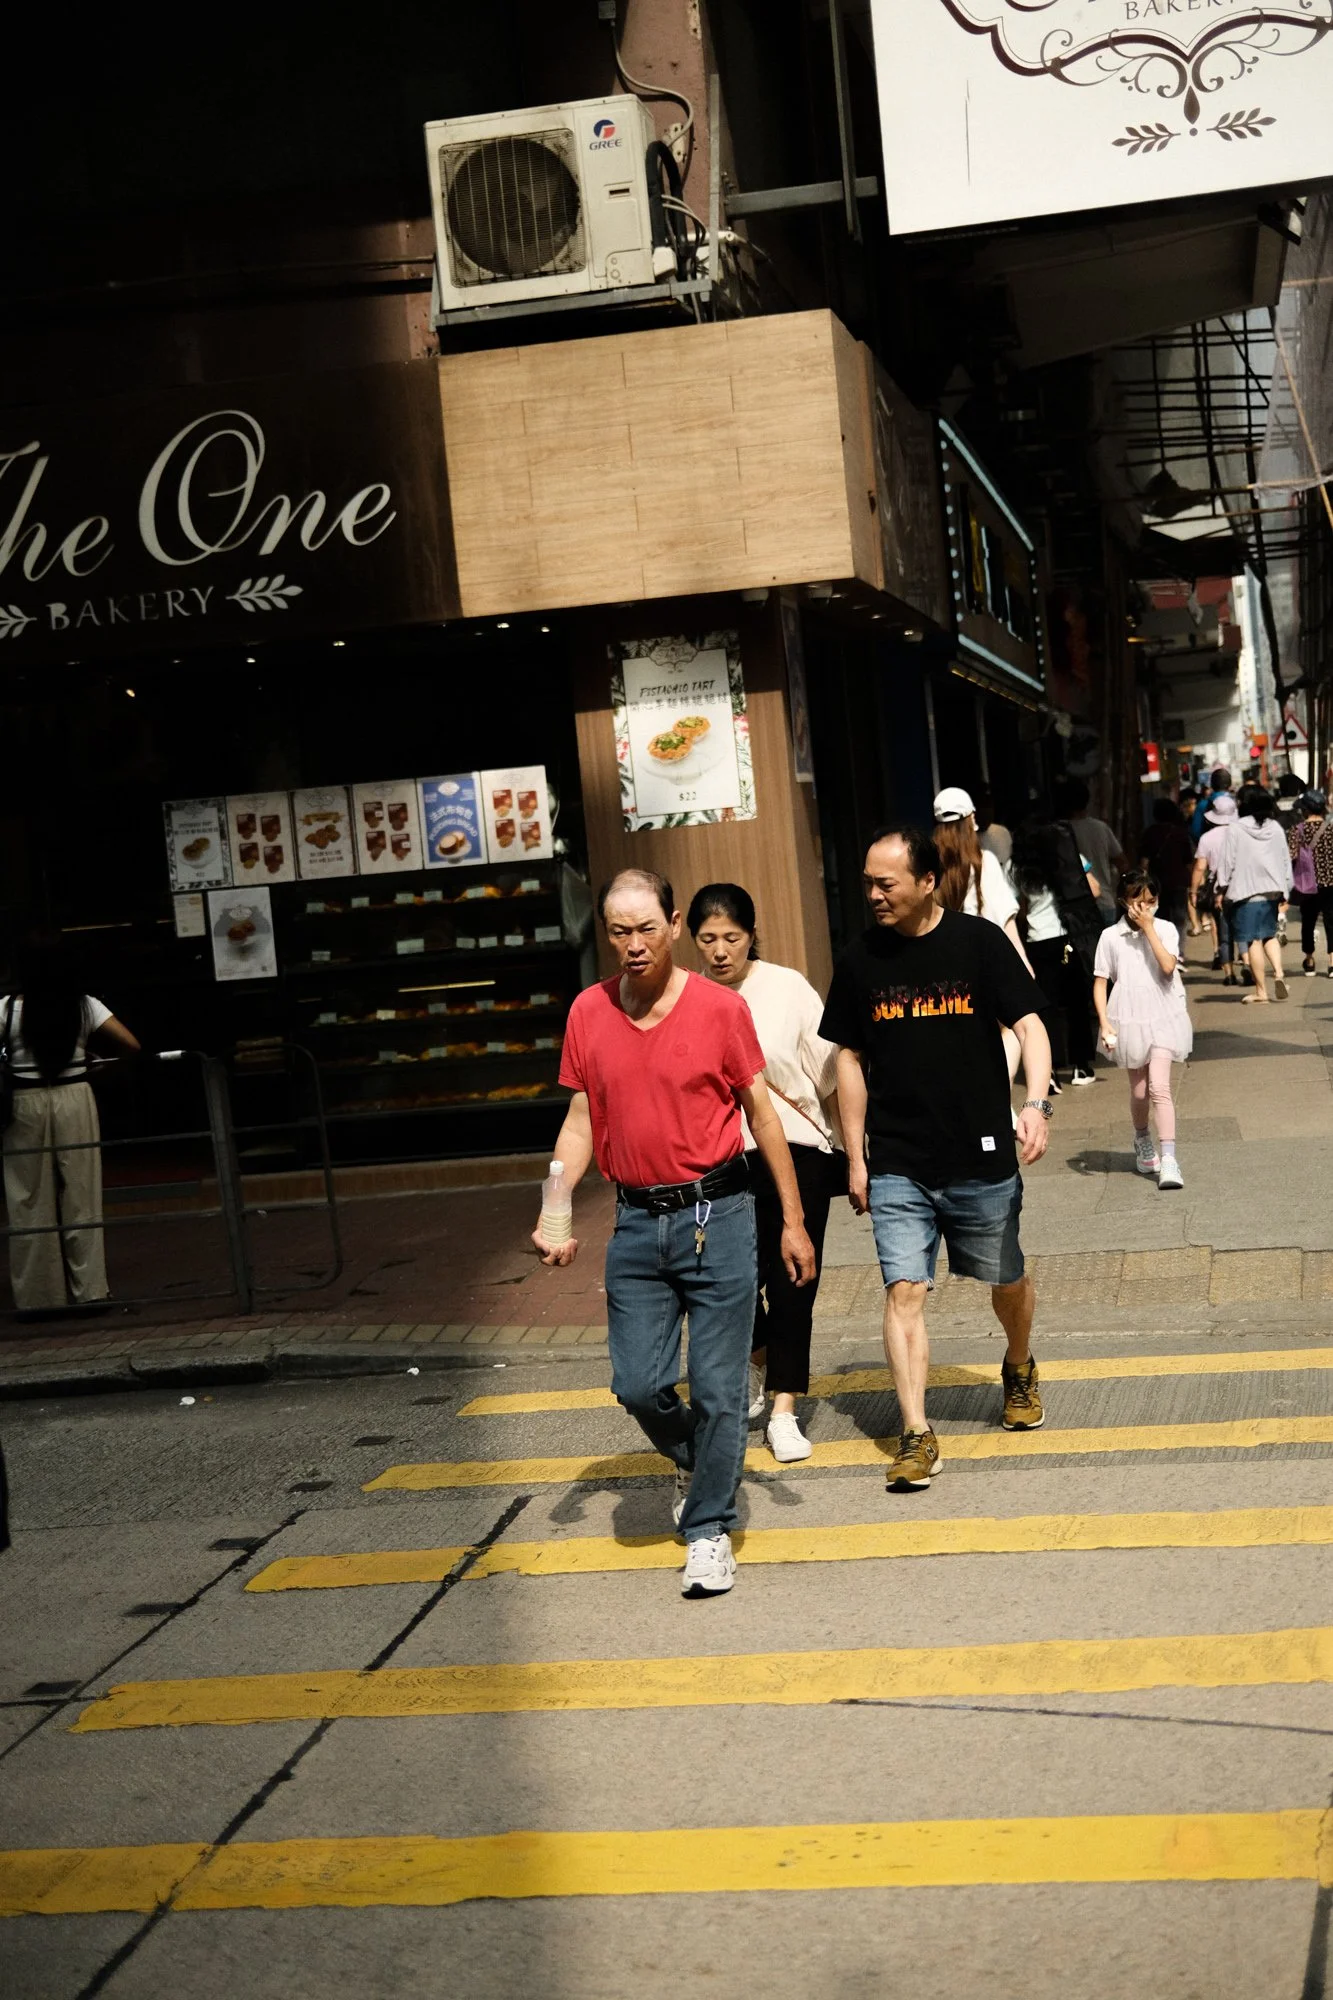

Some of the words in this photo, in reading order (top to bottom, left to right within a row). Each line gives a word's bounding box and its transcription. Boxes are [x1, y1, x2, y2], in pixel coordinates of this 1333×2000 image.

[1125, 0, 1234, 20] BAKE
[589, 139, 622, 151] GREE
[0, 440, 115, 582] he
[139, 410, 397, 565] One
[45, 586, 217, 631] BAKERY
[639, 682, 689, 698] PISTACHIO
[691, 680, 716, 692] TART
